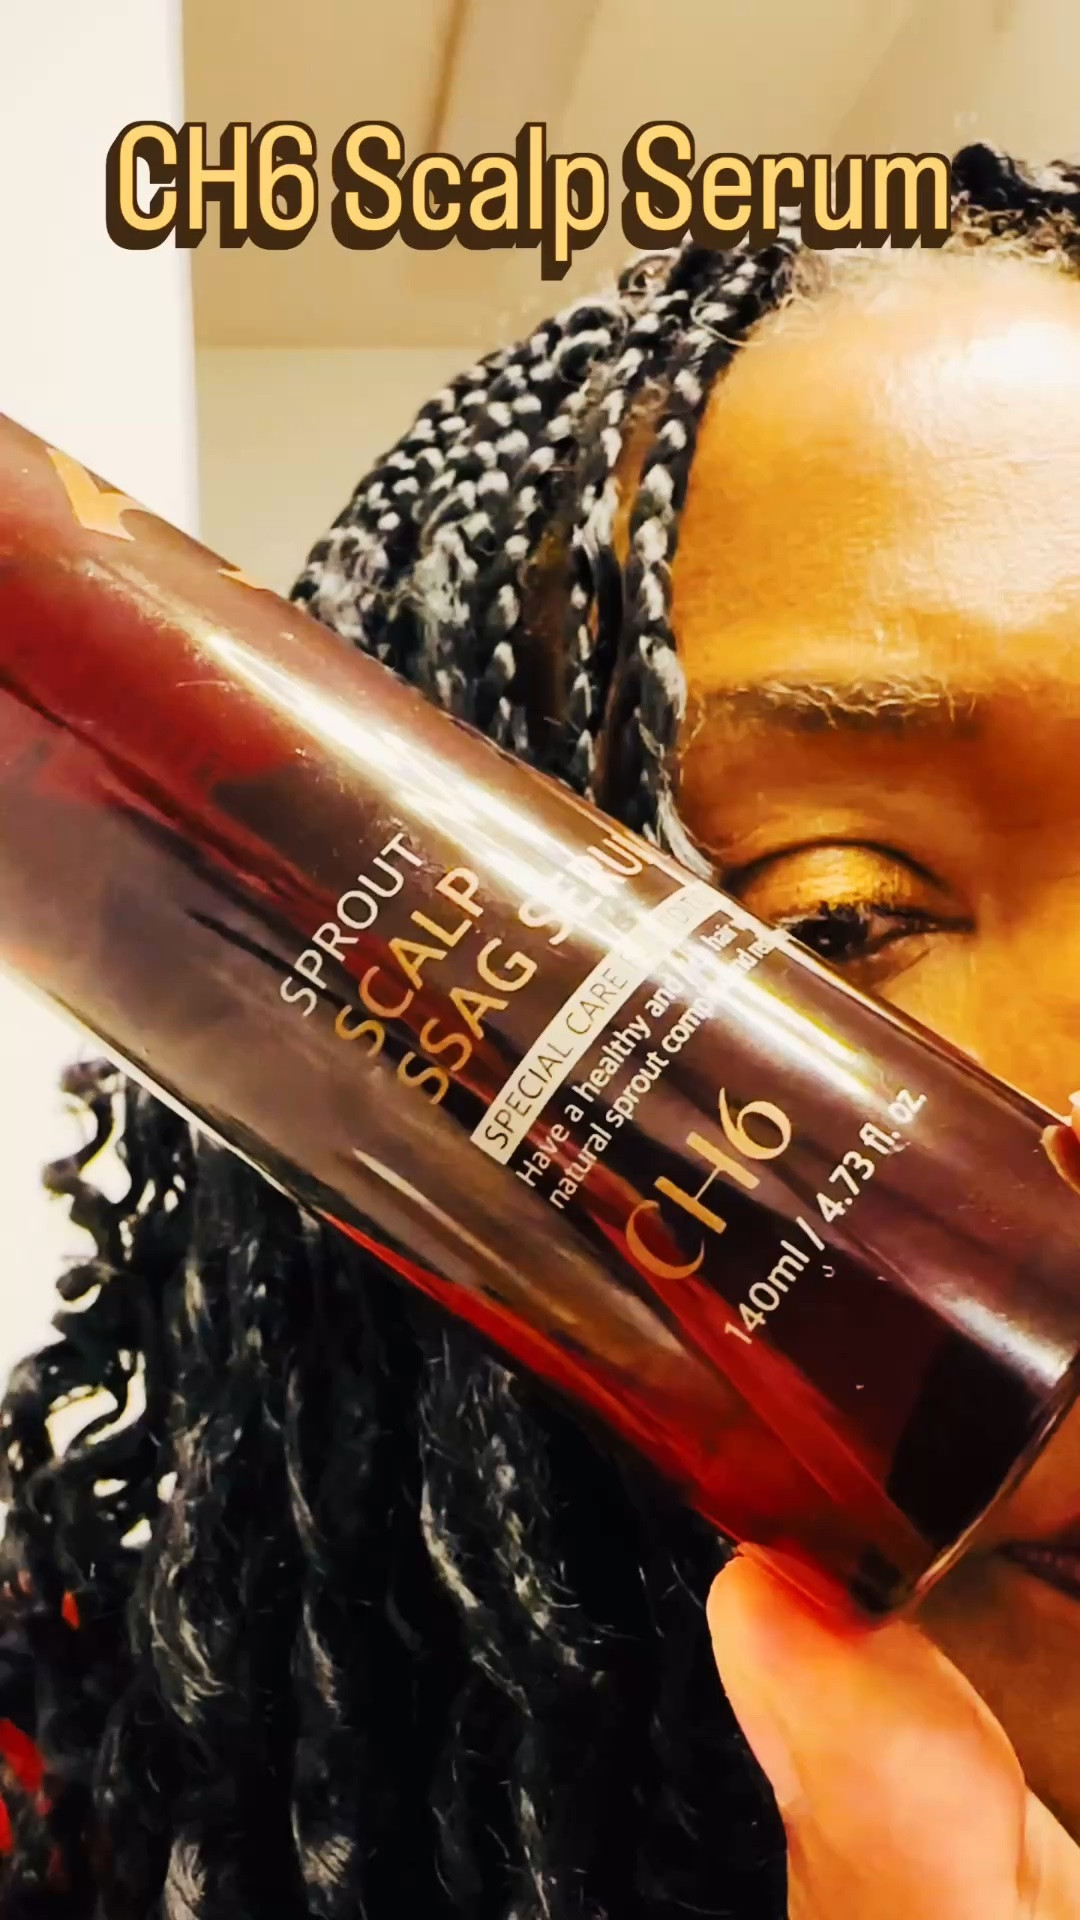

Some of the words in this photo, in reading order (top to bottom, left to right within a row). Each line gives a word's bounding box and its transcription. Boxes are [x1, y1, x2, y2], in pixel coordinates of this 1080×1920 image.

[279, 832, 424, 1017] SPROUT
[334, 867, 484, 1058] SCALP
[644, 969, 687, 1018] and
[396, 937, 538, 1105] SSAG
[484, 1042, 575, 1150] SPECIAL
[565, 967, 629, 1035] CARE
[571, 1014, 652, 1103] healthy
[515, 1123, 570, 1188] Have
[549, 1122, 613, 1210] natural
[605, 1050, 670, 1128] sprout
[564, 1103, 585, 1123] a
[625, 1086, 792, 1280] CH6
[724, 1239, 810, 1344] 140ml
[795, 1215, 826, 1251] /
[815, 1150, 876, 1223] 4.73
[858, 1121, 901, 1155] fl.
